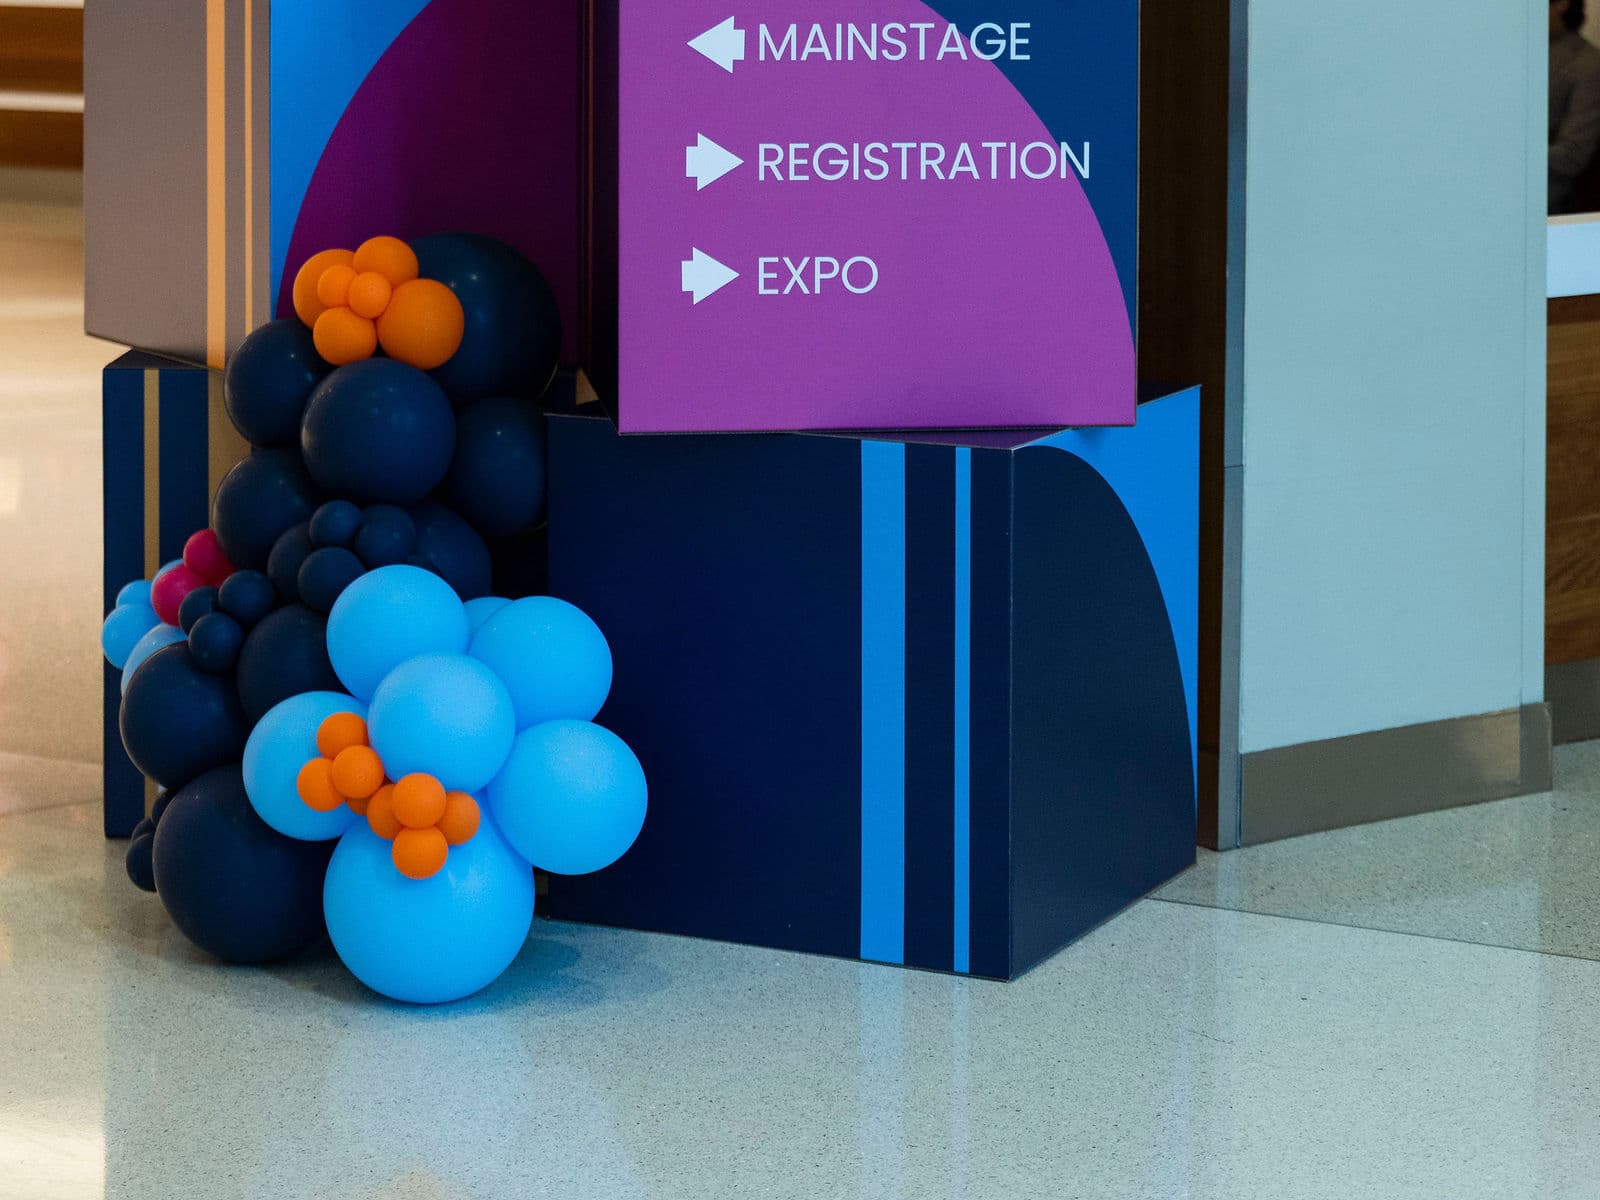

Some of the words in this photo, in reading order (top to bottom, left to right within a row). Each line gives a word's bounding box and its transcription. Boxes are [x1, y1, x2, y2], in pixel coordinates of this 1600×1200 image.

[758, 22, 1031, 61] MAINSTAGE
[758, 141, 1090, 181] REGISTRATION
[758, 256, 879, 294] EXPO
